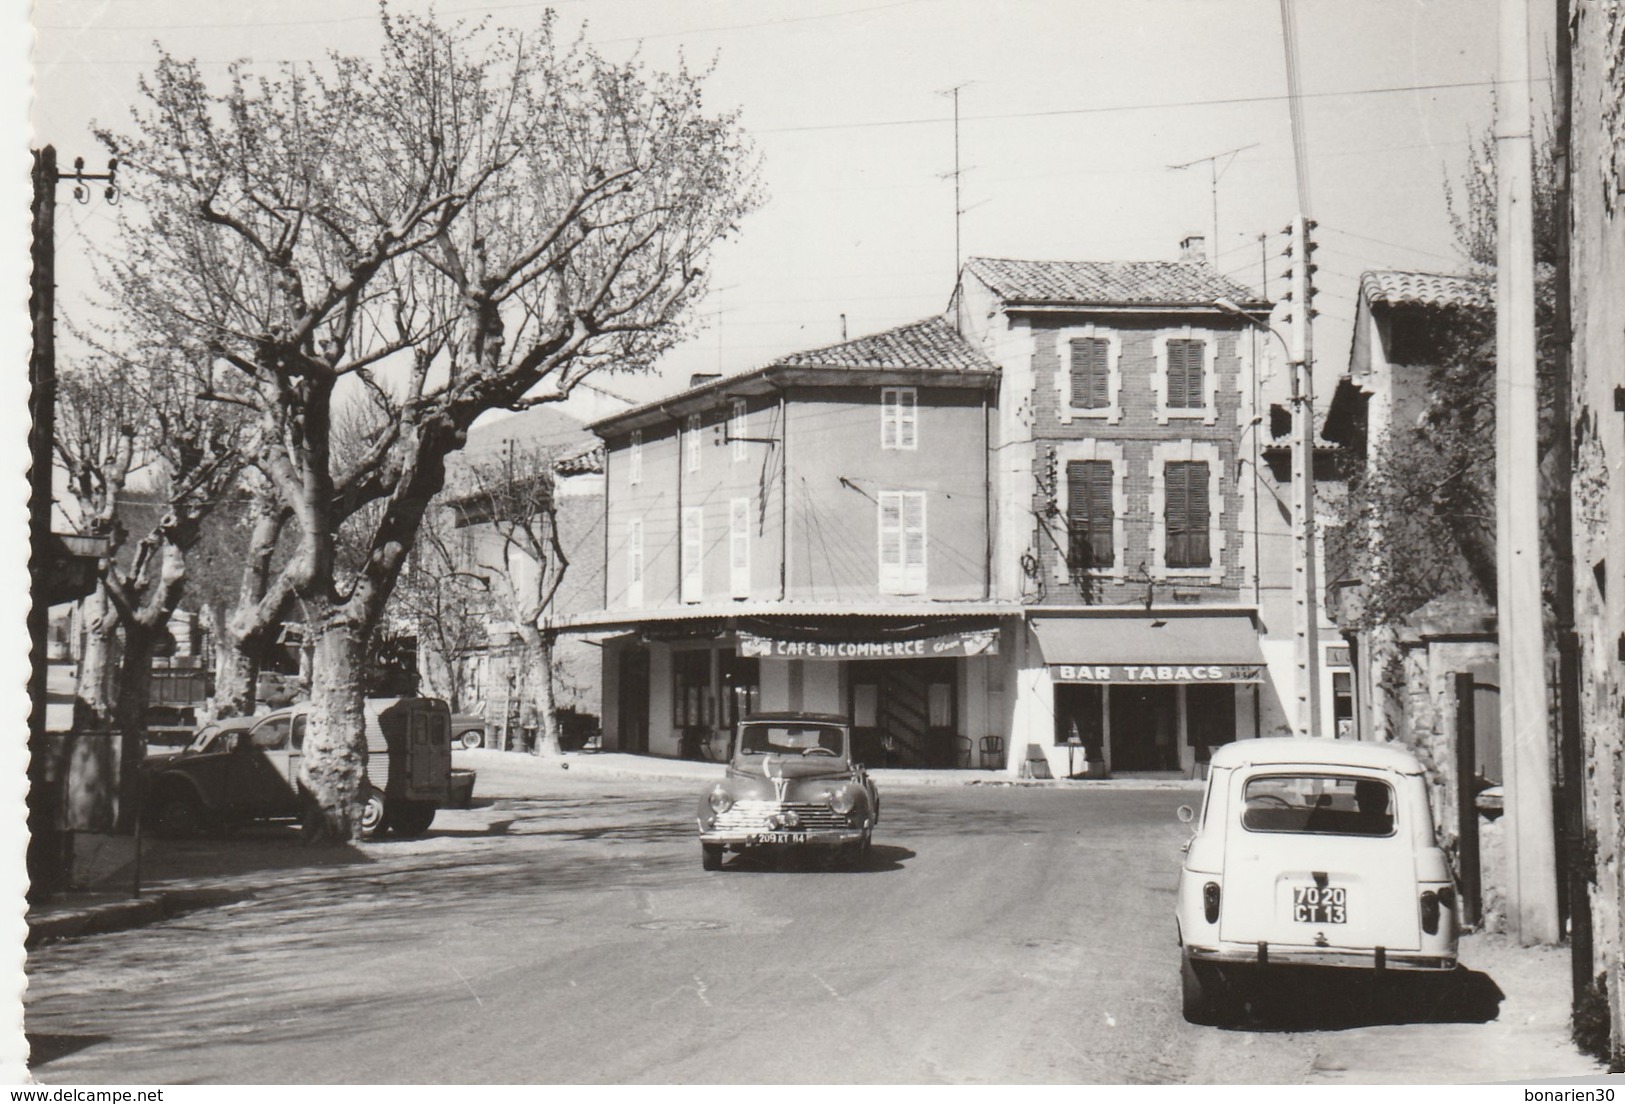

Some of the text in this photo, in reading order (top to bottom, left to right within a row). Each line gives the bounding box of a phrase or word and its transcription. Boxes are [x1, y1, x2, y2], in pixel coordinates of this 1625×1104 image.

[777, 641, 816, 656] CAFE
[820, 644, 835, 656] DU
[838, 640, 925, 656] COMMERCE
[1060, 665, 1111, 680] BAR
[1123, 665, 1223, 680] TABACS
[759, 834, 777, 843] 209
[1295, 904, 1345, 922] CT 13
